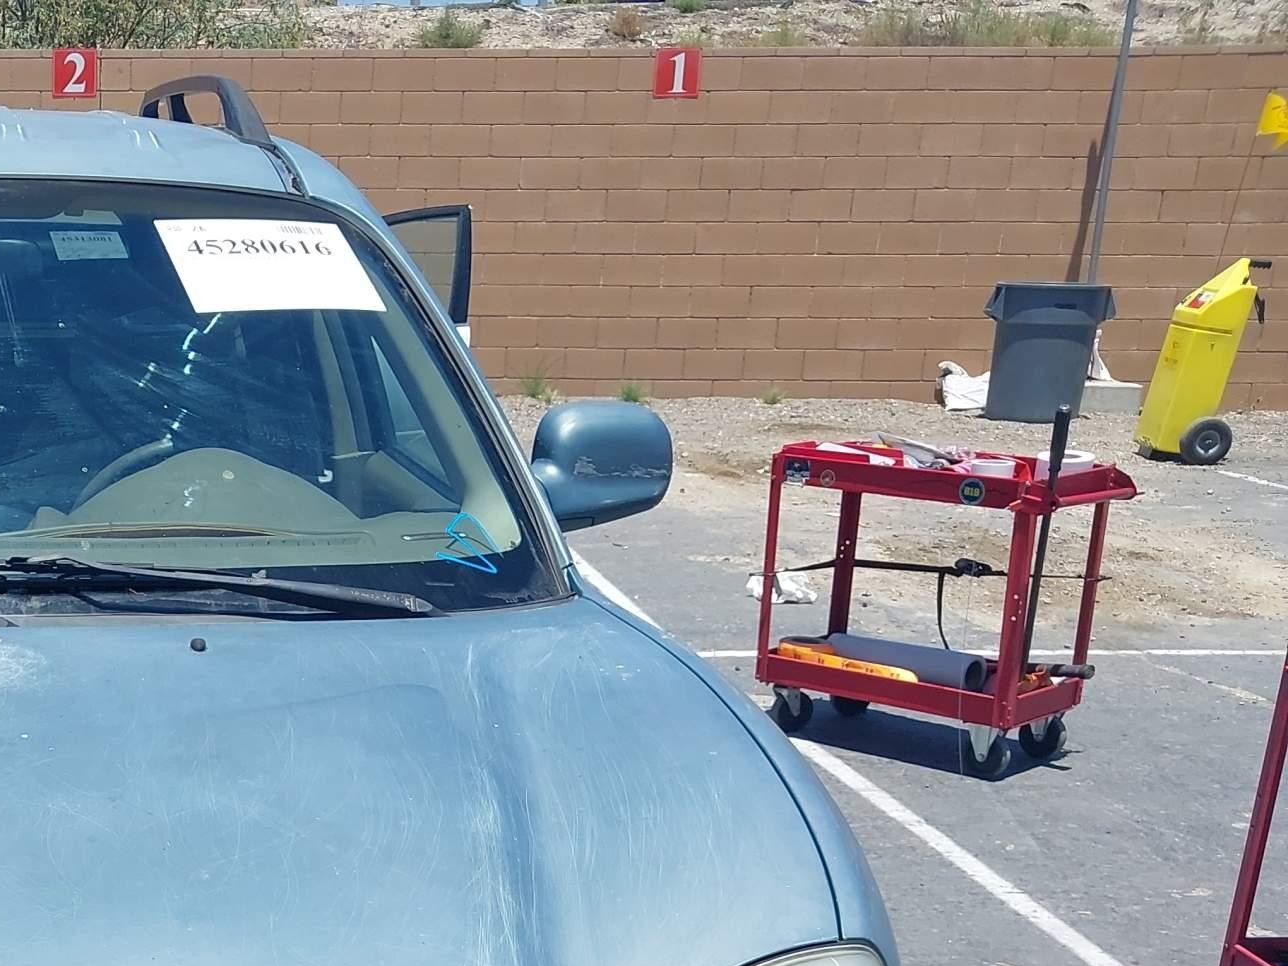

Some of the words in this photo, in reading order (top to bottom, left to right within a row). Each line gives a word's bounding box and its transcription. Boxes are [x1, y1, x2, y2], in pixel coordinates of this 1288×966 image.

[62, 52, 86, 93] 2
[666, 51, 688, 93] 1
[187, 238, 333, 256] 45280616
